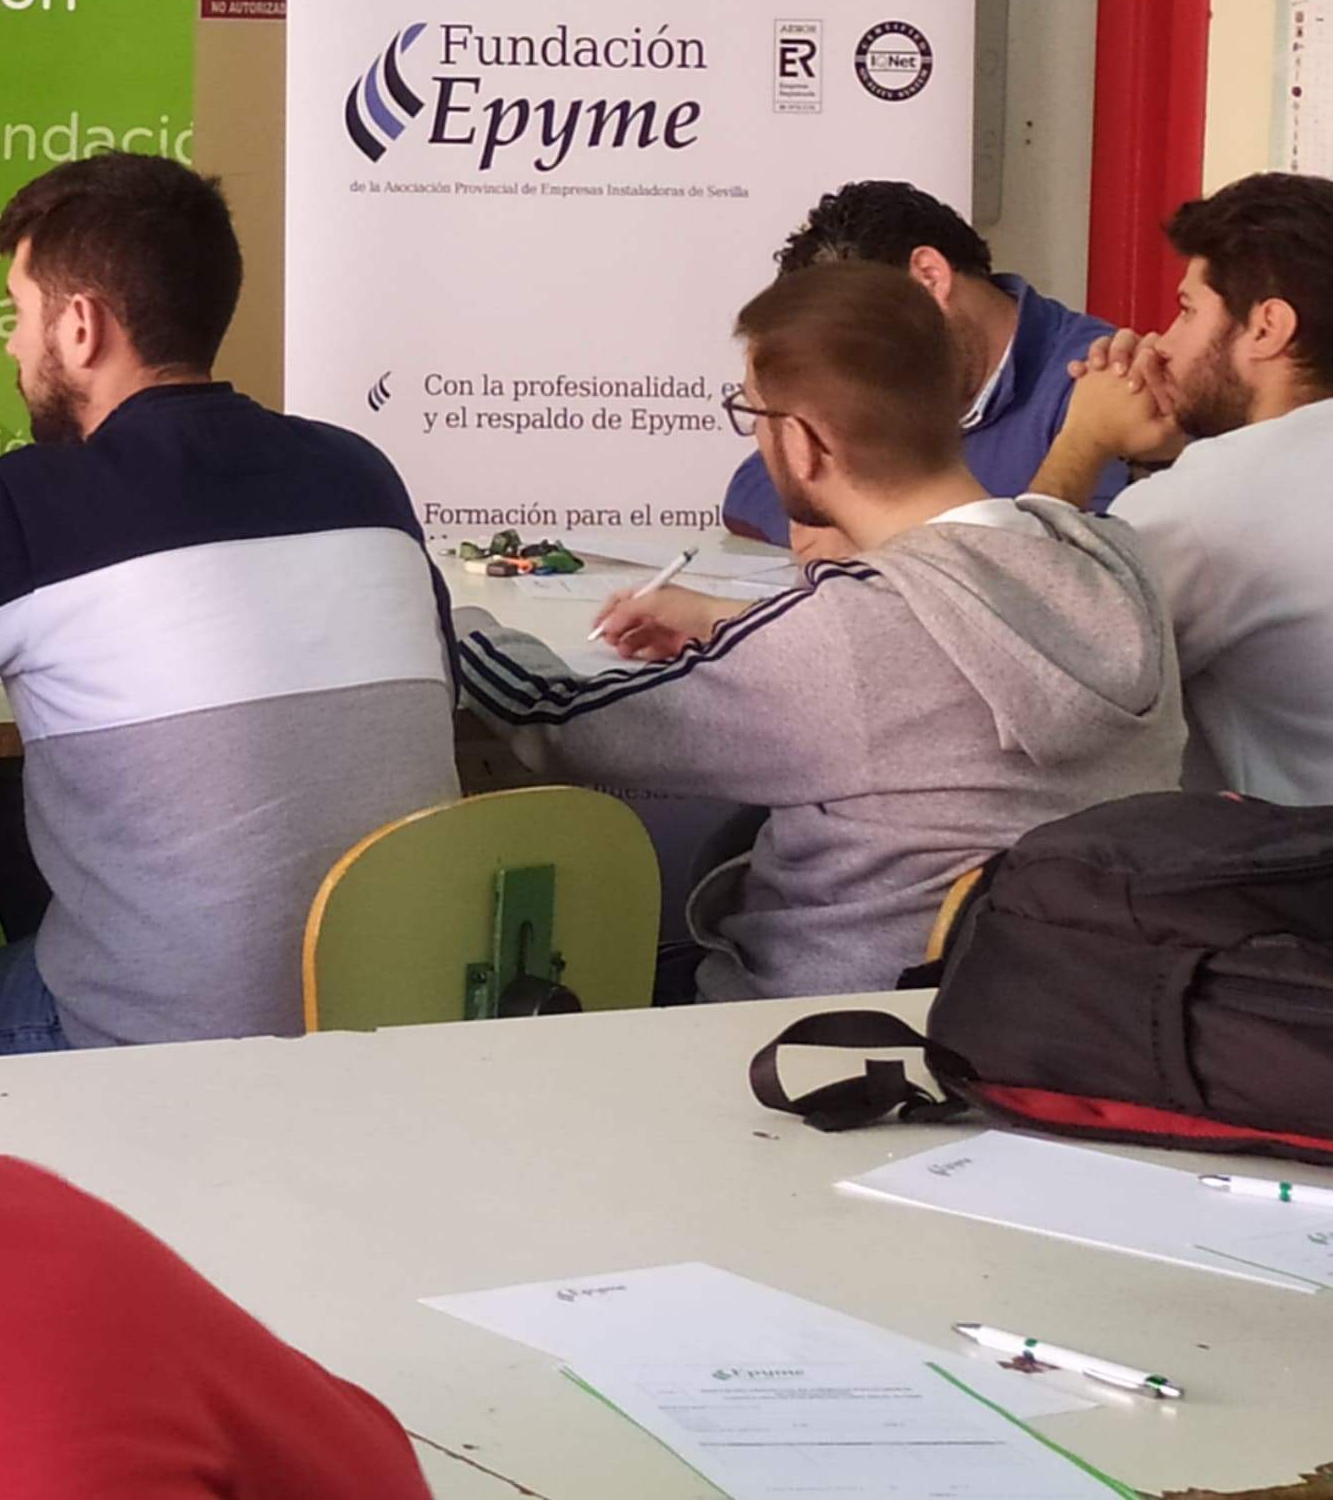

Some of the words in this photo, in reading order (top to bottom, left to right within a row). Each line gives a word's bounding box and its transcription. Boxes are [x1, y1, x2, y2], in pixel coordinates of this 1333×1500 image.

[211, 2, 227, 13] NO
[439, 23, 708, 69] Fundación
[779, 39, 817, 78] ER
[428, 77, 701, 171] Epyme
[350, 181, 365, 192] de
[369, 181, 381, 192] la
[384, 181, 451, 194] Asociación
[455, 182, 518, 195] Provincial
[521, 184, 537, 195] de
[541, 184, 604, 198] Empresas
[607, 185, 686, 197] Instaladoras
[689, 186, 704, 197] de
[707, 186, 749, 198] Sevilla
[424, 374, 474, 397] Con
[482, 374, 504, 397] la
[513, 375, 713, 403] profesionalidad,
[424, 413, 436, 434] y
[445, 407, 467, 429] el
[475, 408, 584, 433] respaldo
[592, 408, 622, 430] de
[629, 410, 722, 436] Epyme.
[424, 502, 558, 526] Formación
[565, 509, 622, 531] para
[630, 504, 652, 526] el
